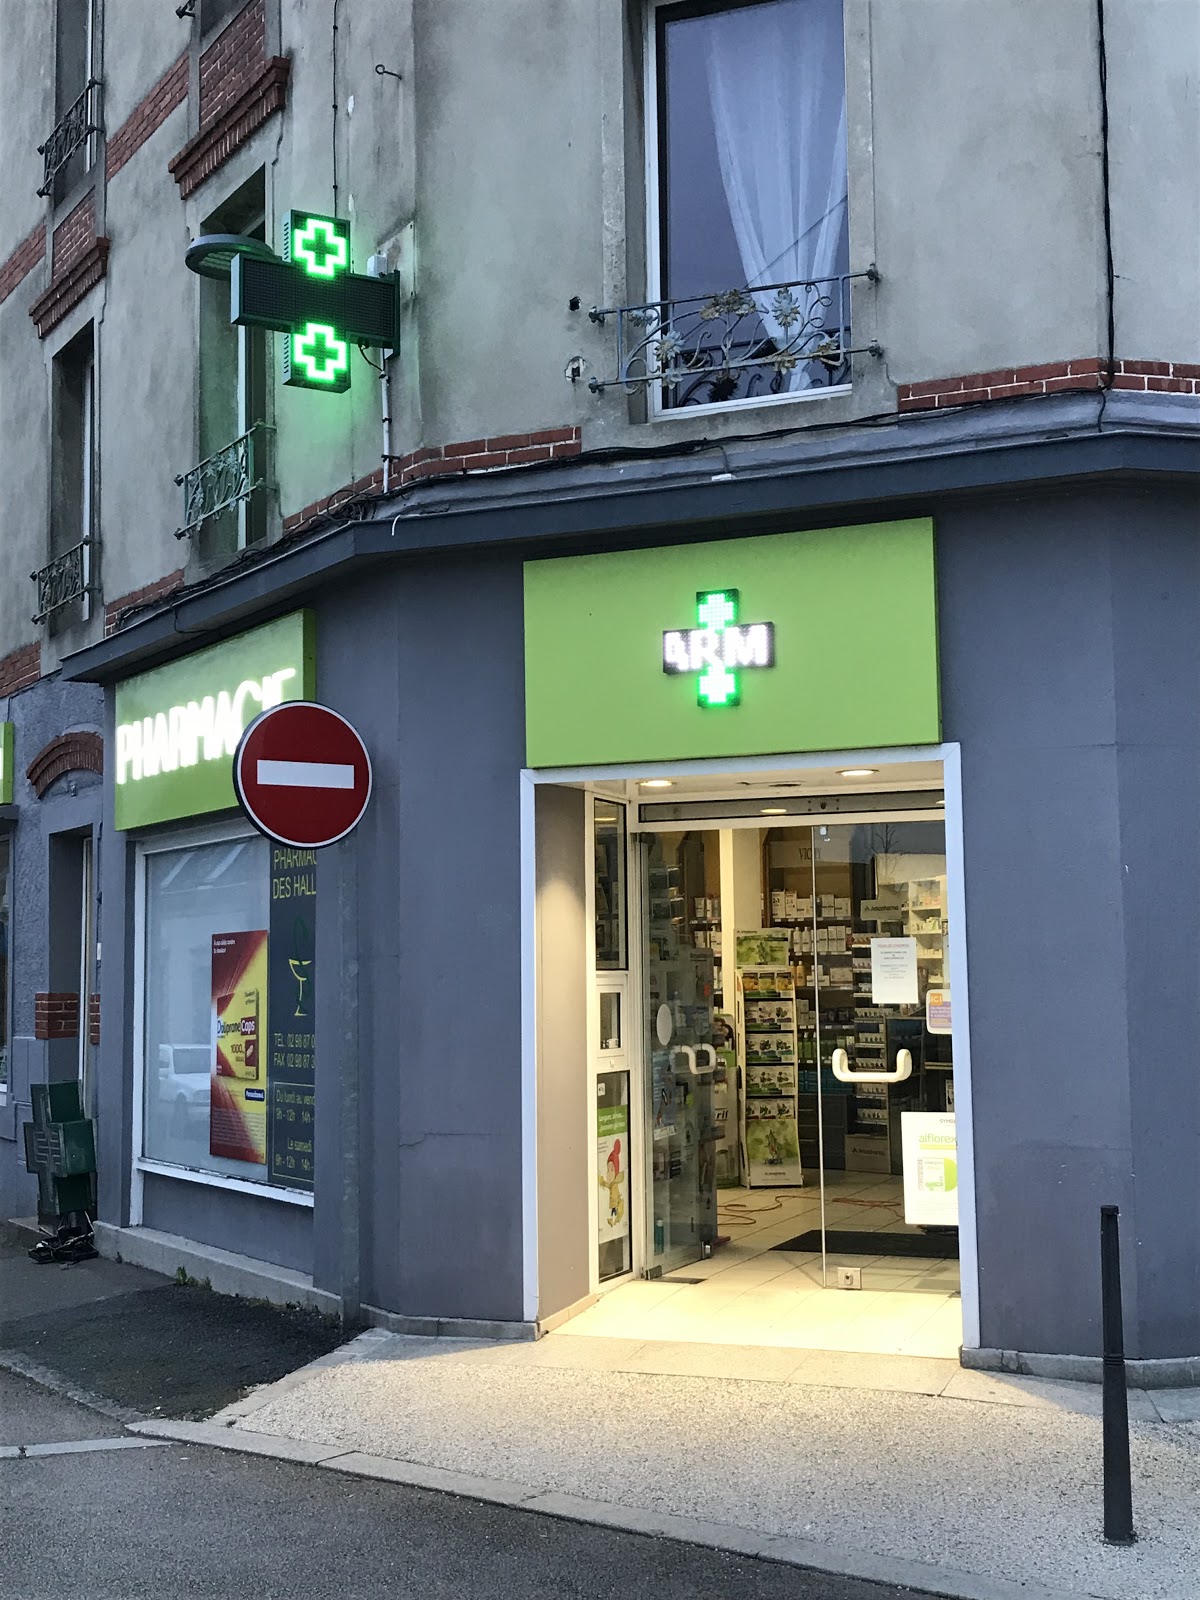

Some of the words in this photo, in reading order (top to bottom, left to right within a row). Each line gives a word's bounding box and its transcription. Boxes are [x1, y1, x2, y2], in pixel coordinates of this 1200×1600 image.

[273, 877, 291, 899] DES
[293, 873, 317, 897] HALL
[241, 1019, 256, 1035] Caps
